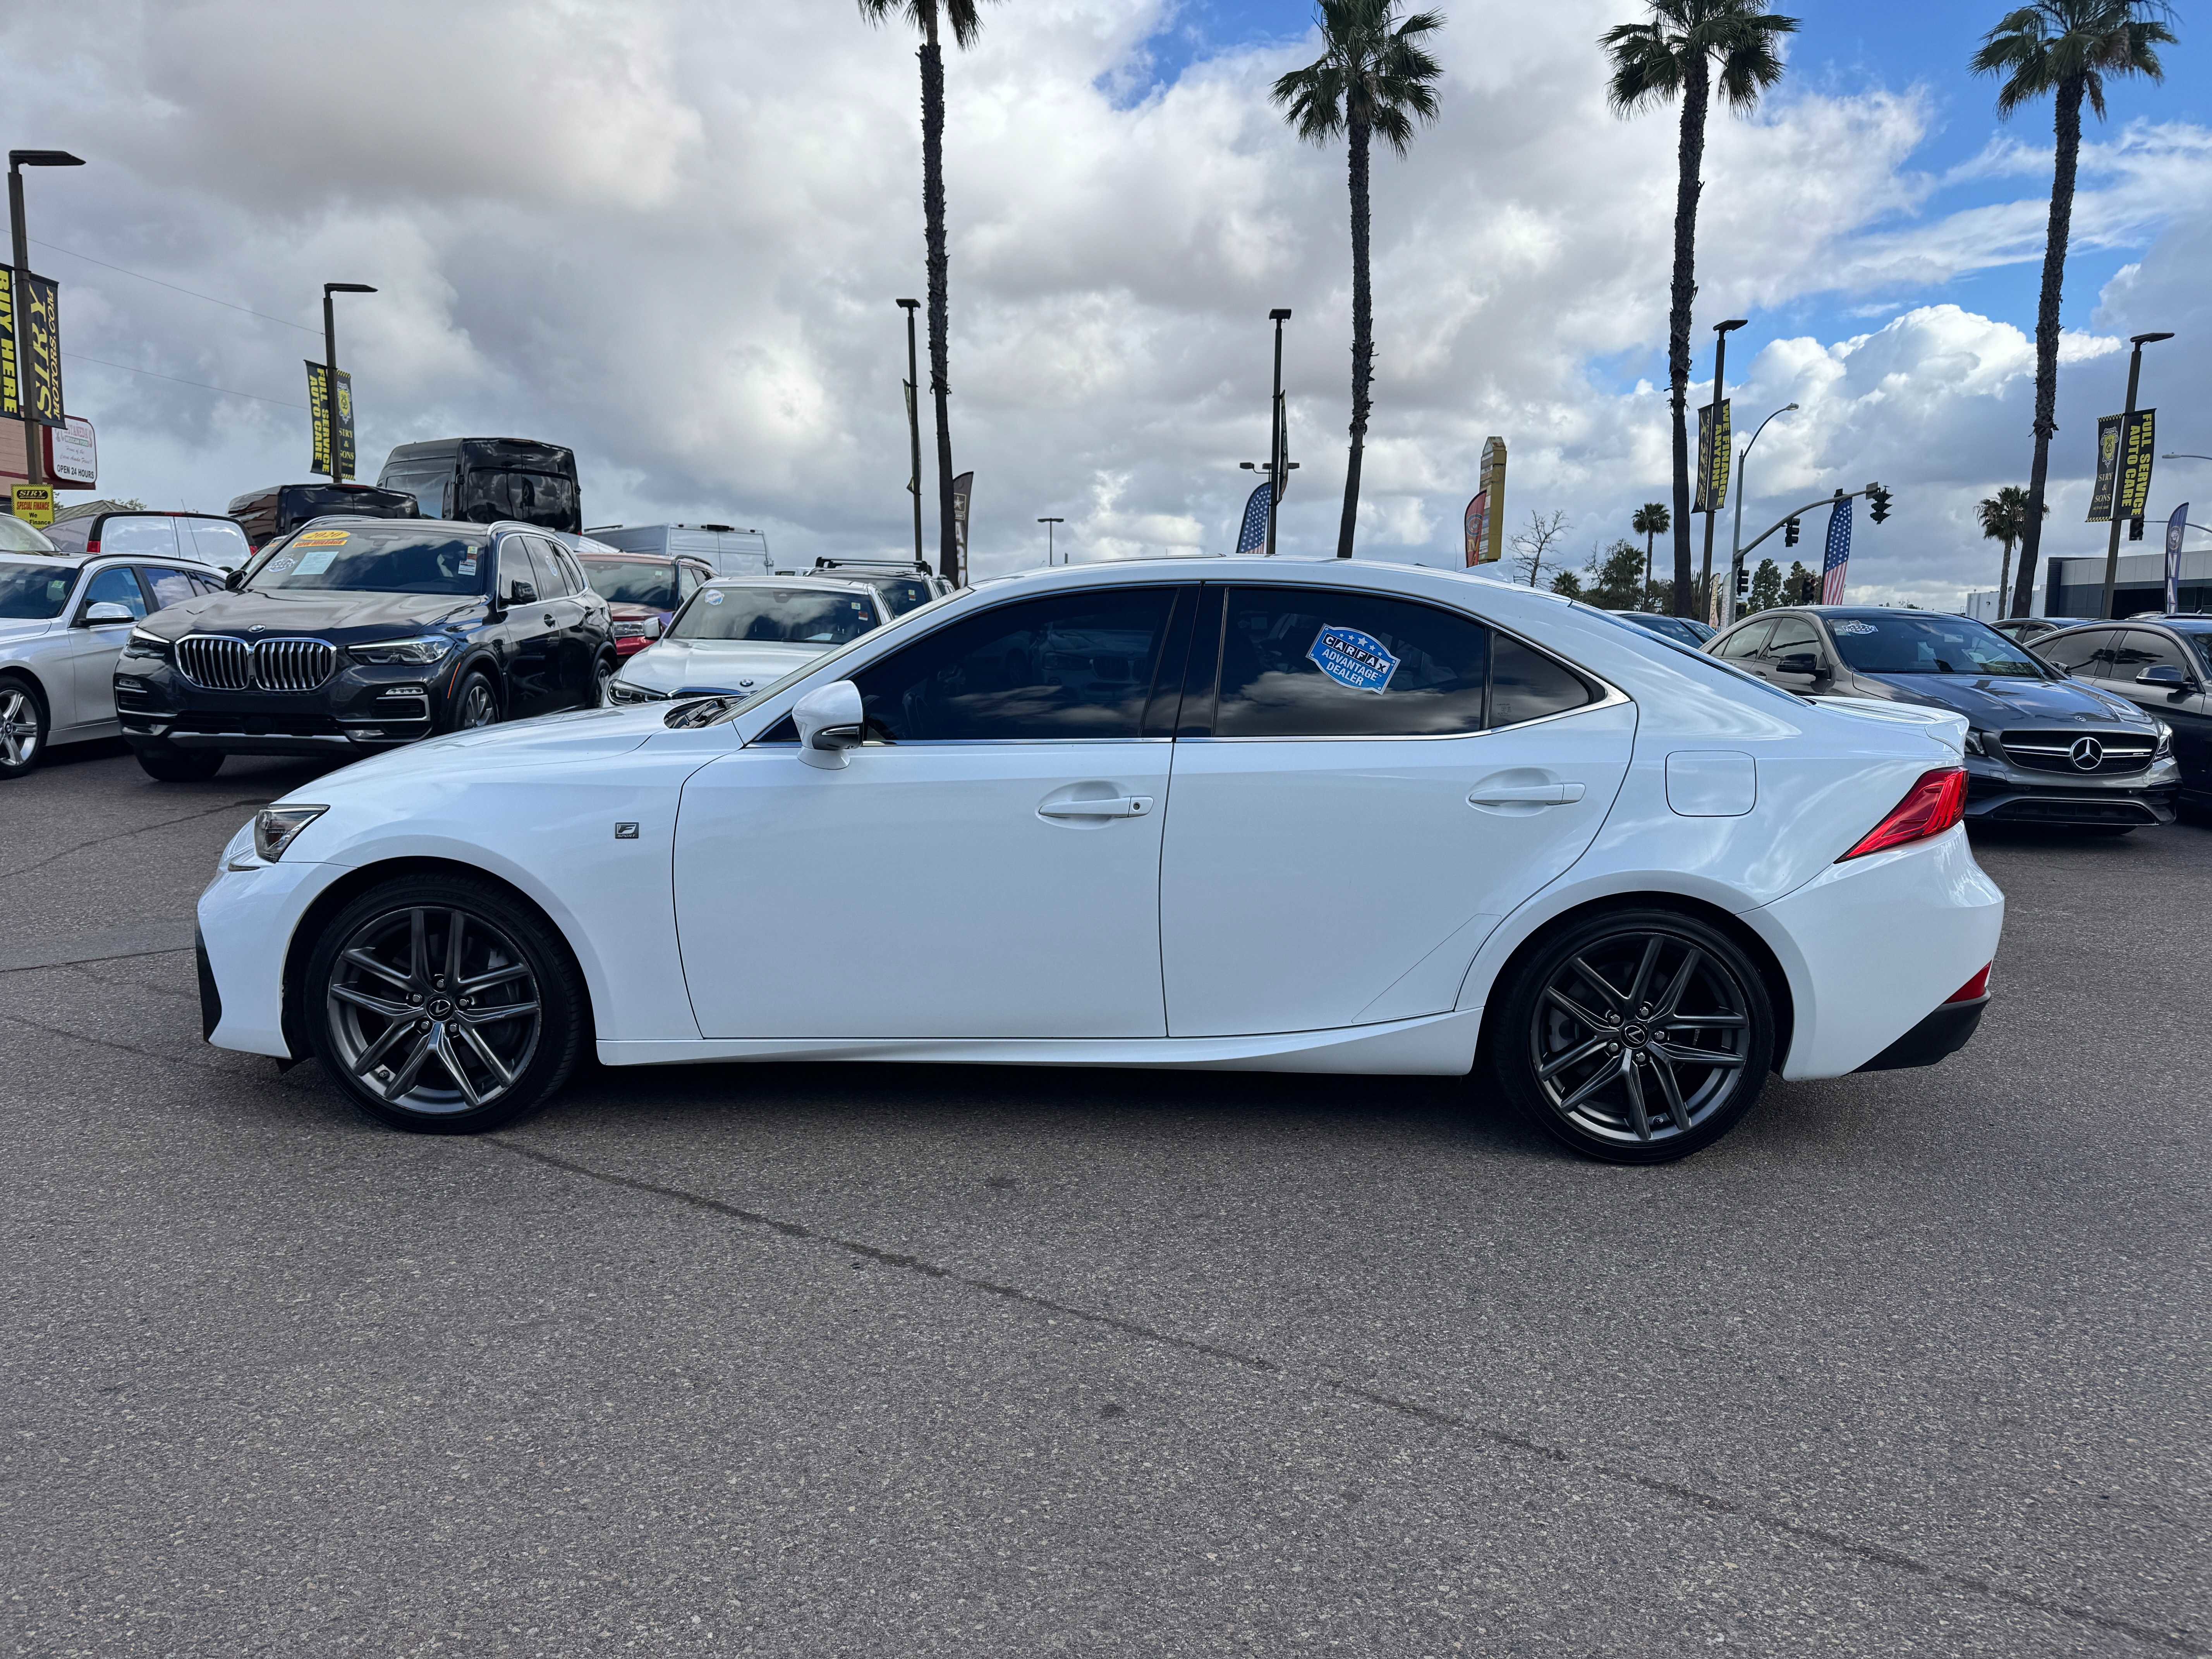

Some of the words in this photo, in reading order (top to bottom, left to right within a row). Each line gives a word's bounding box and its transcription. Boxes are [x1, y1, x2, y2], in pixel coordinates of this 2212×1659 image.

[29, 282, 52, 419] SIRY
[46, 286, 60, 420] MOTORS.COM
[1, 338, 17, 413] HERE
[317, 368, 328, 401] FULL
[309, 375, 321, 417] AUTO
[339, 428, 353, 438] SIRY
[1723, 404, 1729, 432] WE
[2141, 414, 2152, 447] FULL
[322, 409, 330, 472] SERVICE
[1712, 424, 1722, 490] ANYONE
[2126, 426, 2140, 465] AUTO
[57, 464, 70, 474] OPEN
[71, 467, 77, 475] 24
[78, 469, 94, 479] HOURS
[1697, 413, 1707, 507] SIRY
[1716, 435, 1729, 506] FINANCE
[2098, 472, 2113, 481] SIRY
[2094, 494, 2111, 503] SONS
[2121, 468, 2136, 507] CARE
[2131, 453, 2150, 516] SERVICE
[17, 501, 32, 510] SPECIAL
[33, 501, 49, 510] FINANCE
[1322, 648, 1376, 682] ADVANTAGE
[1326, 636, 1387, 672] CARFAX
[1326, 661, 1364, 686] DEALER
